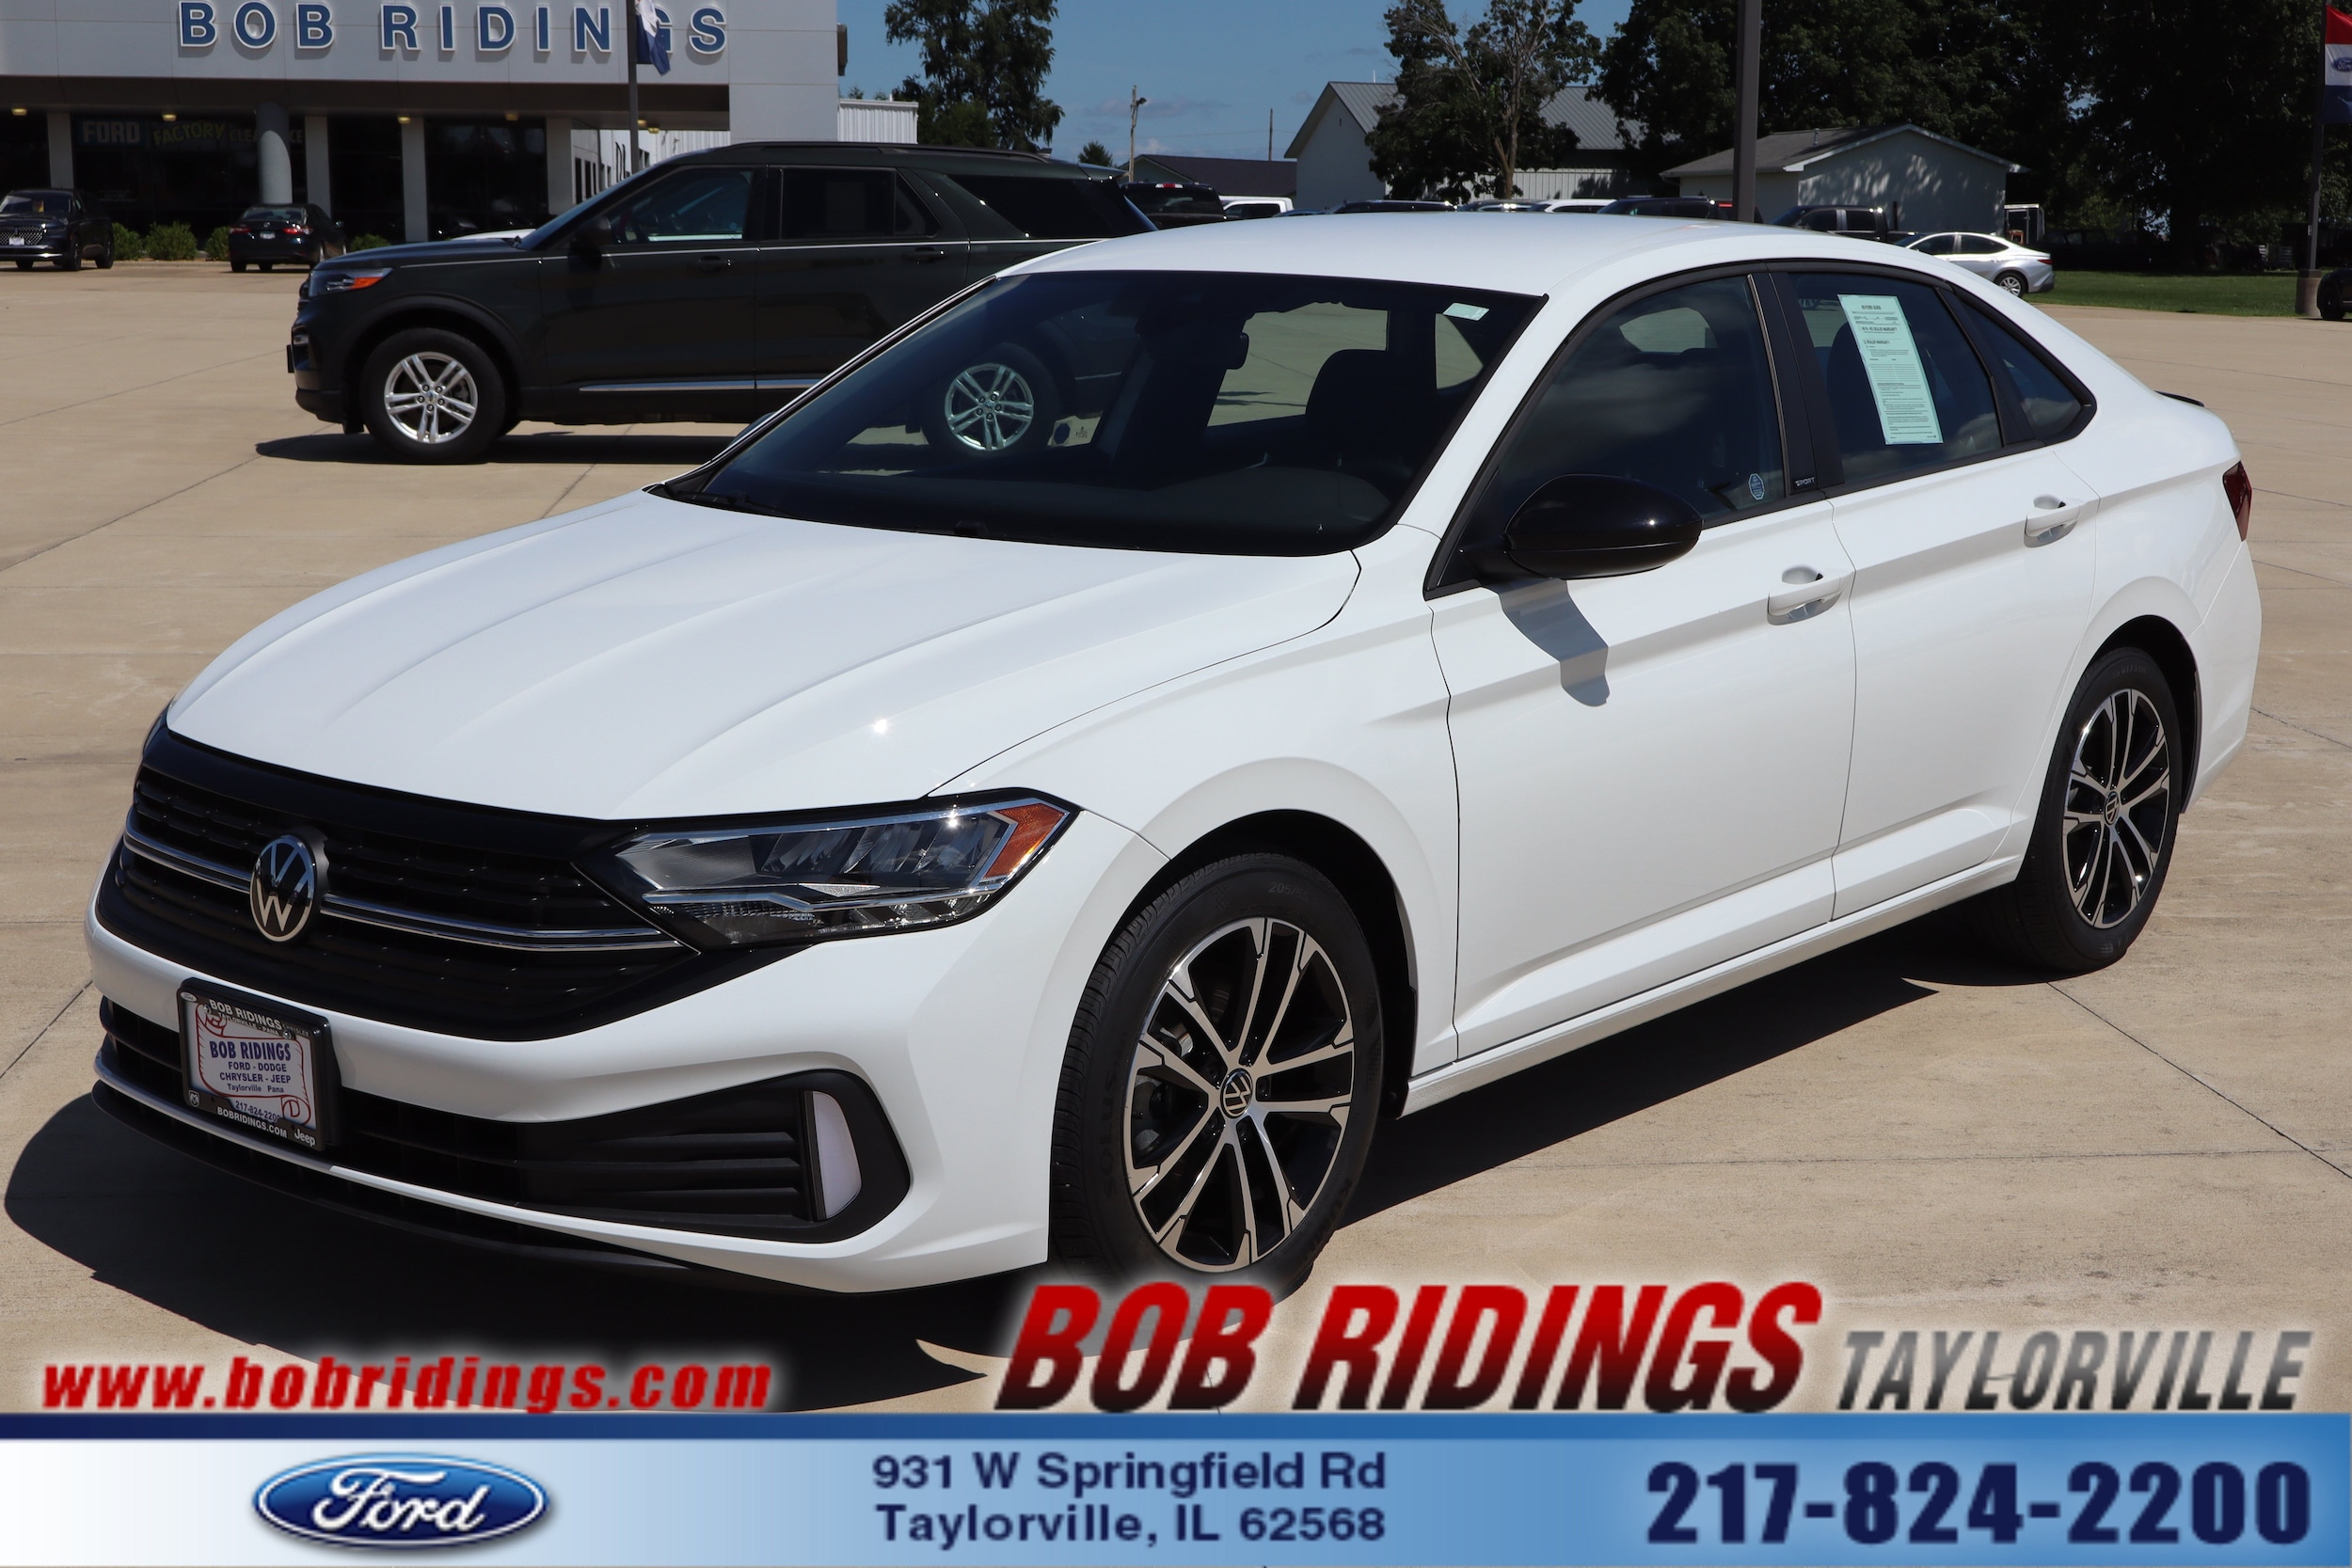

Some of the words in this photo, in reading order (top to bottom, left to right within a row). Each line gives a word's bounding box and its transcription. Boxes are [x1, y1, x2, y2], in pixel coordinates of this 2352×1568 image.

[178, 1, 335, 49] BOB
[82, 120, 140, 144] FORD
[151, 121, 227, 147] FACTORY
[229, 128, 304, 143] CLECE
[1794, 477, 1816, 487] SPORT
[208, 999, 233, 1015] BOB
[234, 1007, 282, 1030] RIDINGS
[209, 1040, 236, 1059] BOB
[241, 1041, 292, 1061] RIDINGS
[228, 1061, 251, 1071] FORD
[258, 1062, 287, 1072] DODGE
[219, 1071, 263, 1083] CHRYSLER
[270, 1073, 292, 1084] JEEP
[227, 1083, 262, 1093] Taylorville
[267, 1085, 284, 1093] Pana
[217, 1106, 288, 1138] BOBRIDINGS.COM
[294, 1128, 316, 1147] Jeep
